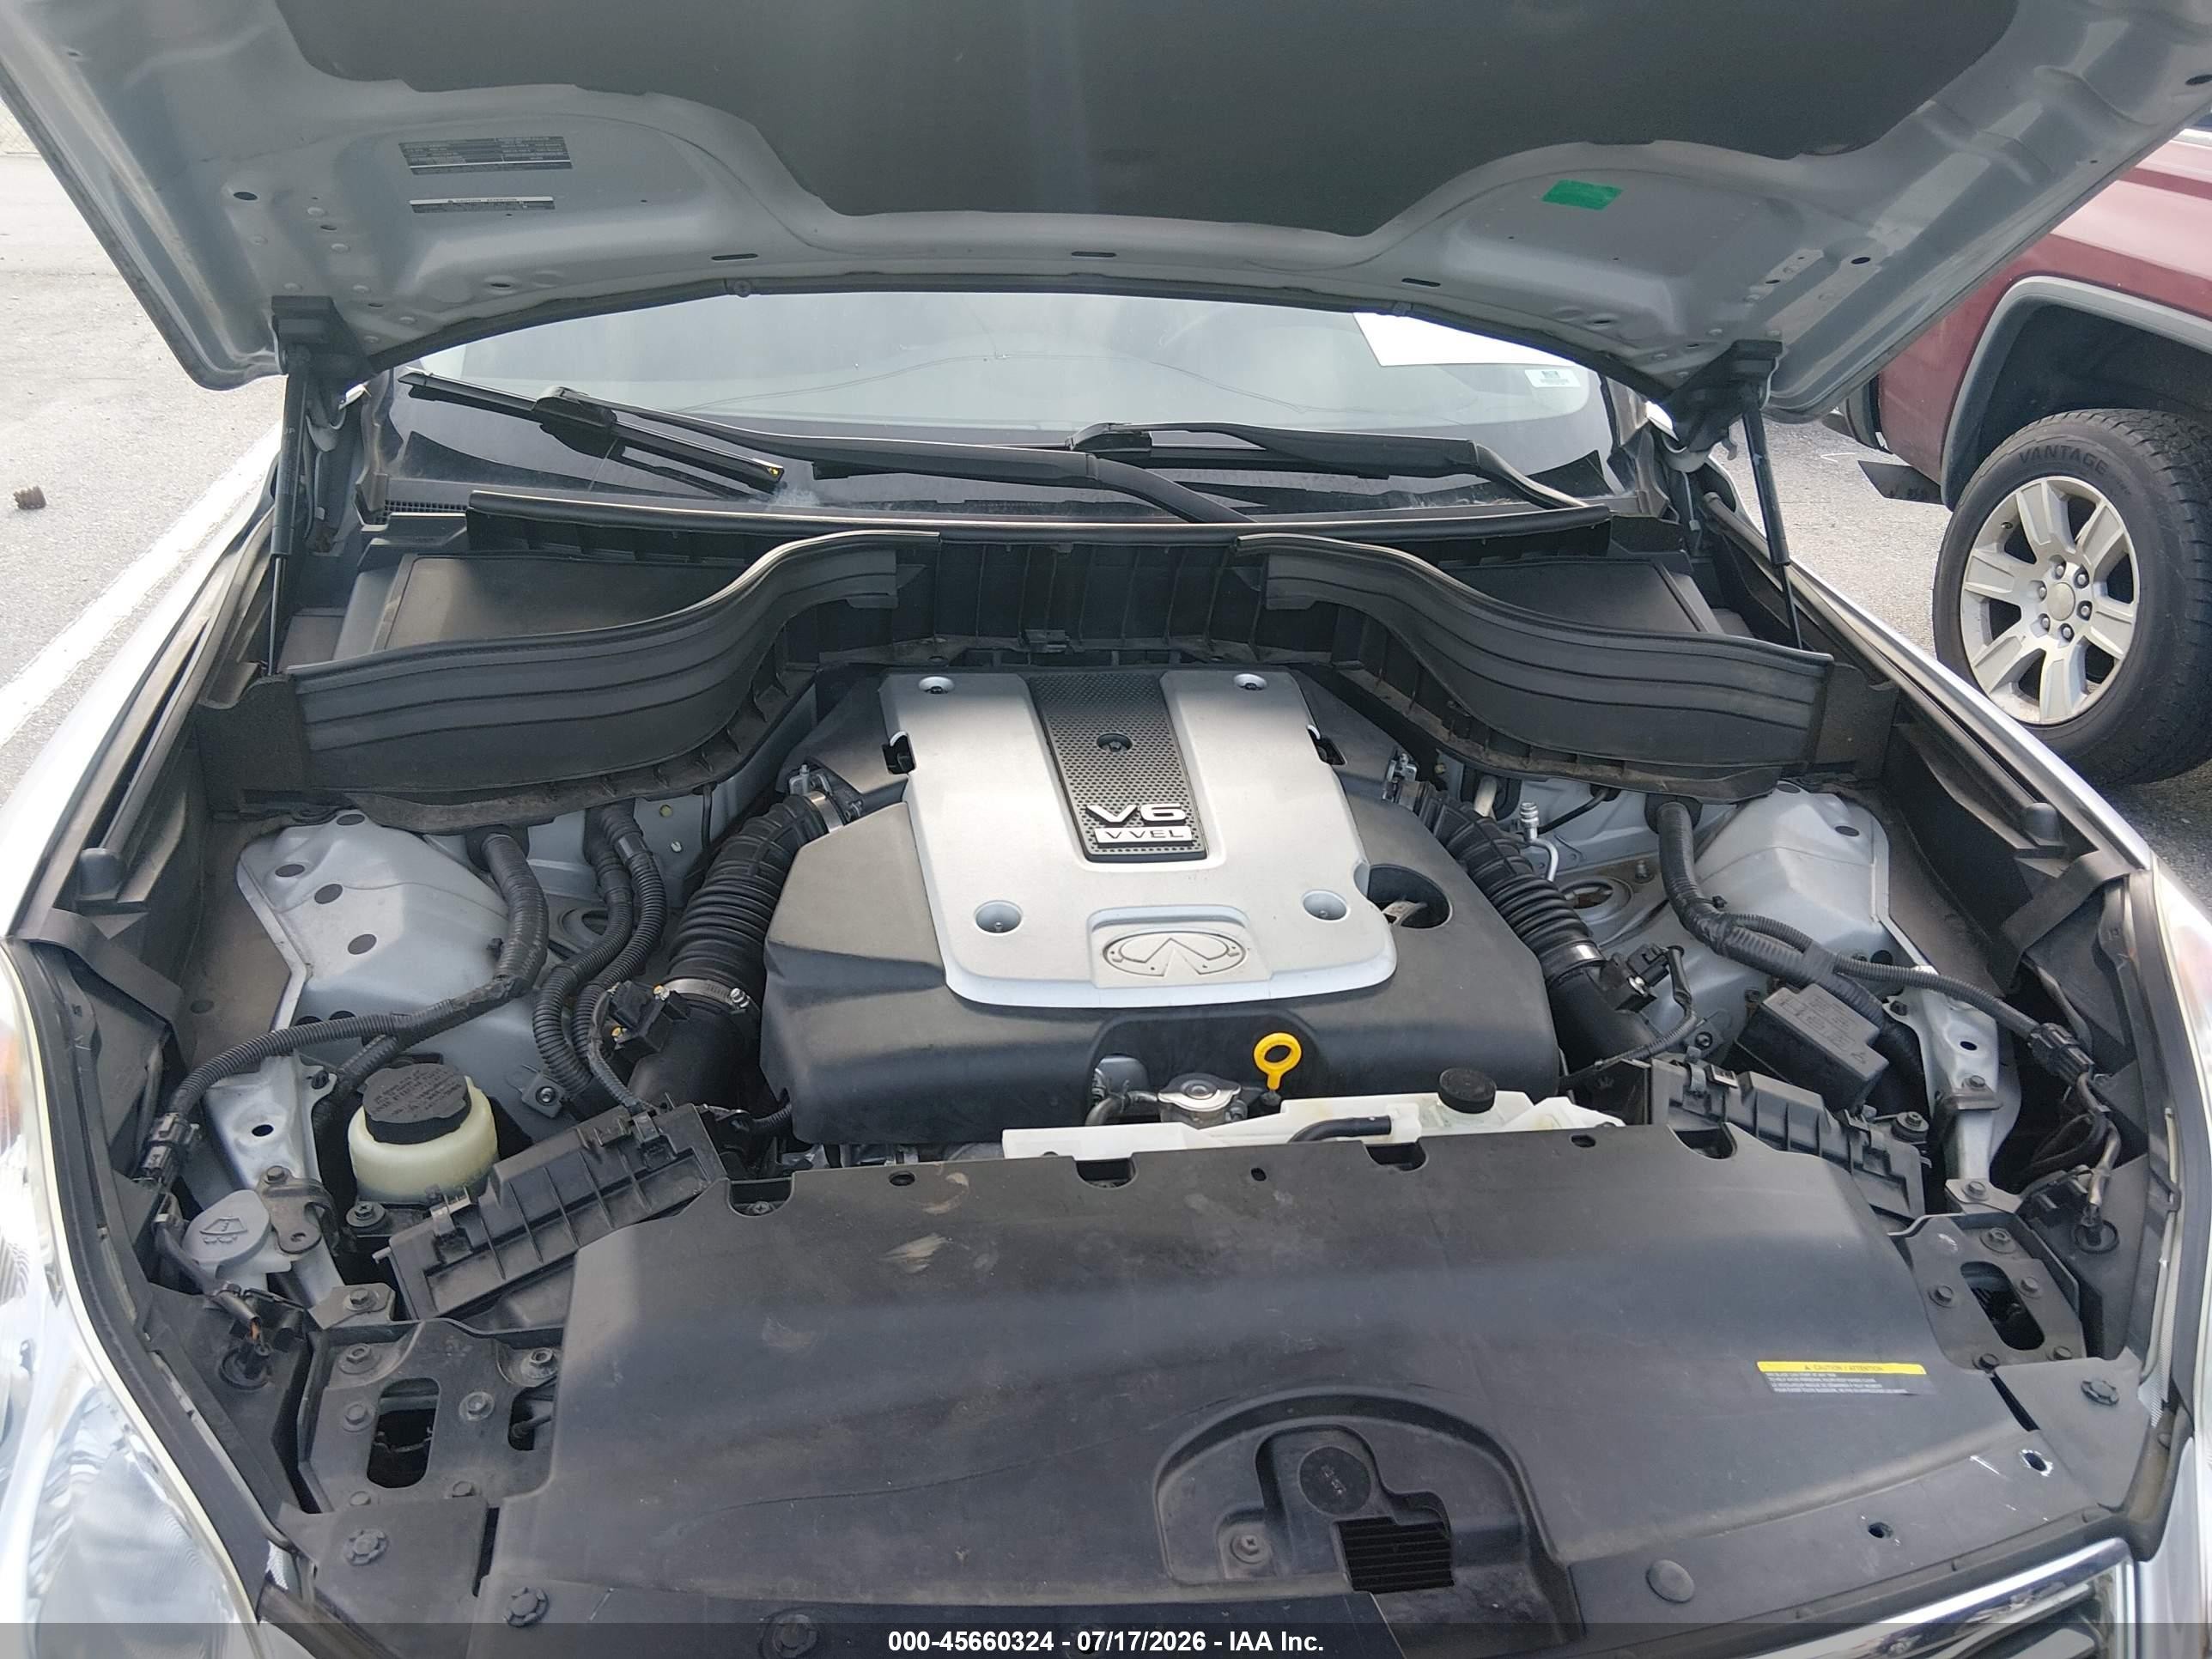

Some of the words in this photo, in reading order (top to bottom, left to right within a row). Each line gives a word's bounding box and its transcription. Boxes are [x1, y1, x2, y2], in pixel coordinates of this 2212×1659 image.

[2019, 444, 2109, 475] VANTAGE
[1085, 803, 1187, 825] V6
[1104, 830, 1184, 839] VVEL
